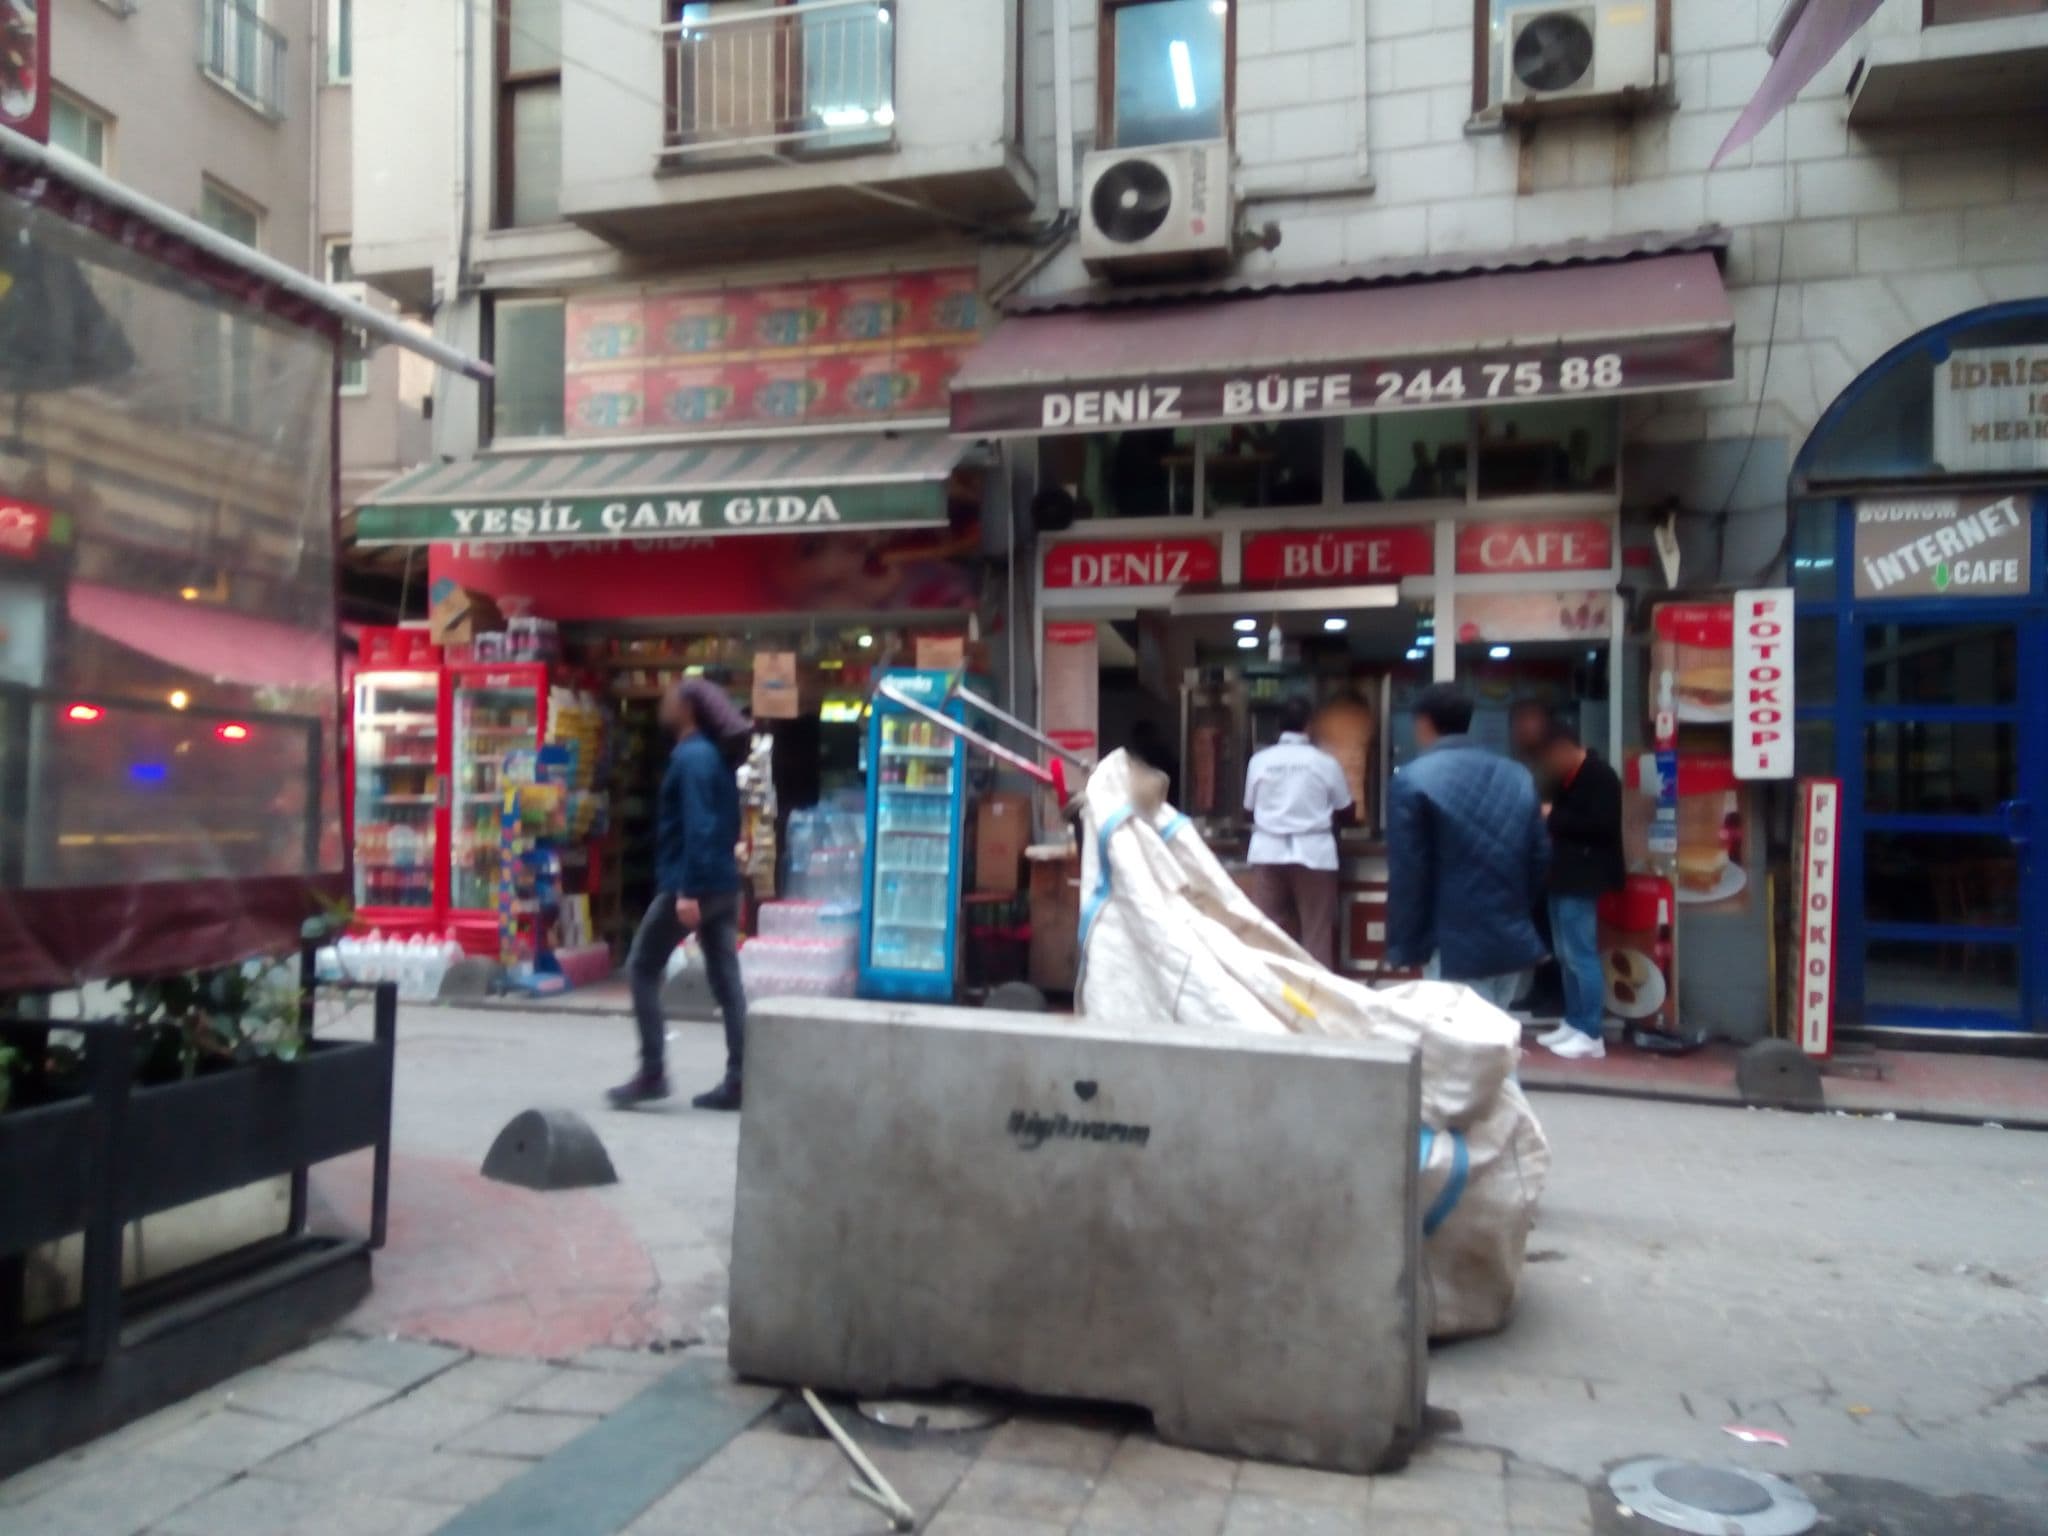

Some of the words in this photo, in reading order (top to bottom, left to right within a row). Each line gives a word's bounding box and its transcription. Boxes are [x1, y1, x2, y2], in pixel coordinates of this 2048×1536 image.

[1042, 384, 1182, 428] DENİZ
[1223, 373, 1352, 416] BÜFE
[1374, 366, 1466, 406] 244
[1482, 361, 1543, 398] 75
[1560, 353, 1624, 391] 88
[450, 501, 582, 538] YEŞİL
[601, 499, 702, 536] ÇAM
[724, 494, 840, 526] GIDA
[1863, 497, 2021, 590] İNTERNET
[1071, 550, 1190, 585] DENİZ
[1283, 536, 1392, 577] BÜFE
[1480, 530, 1587, 567] CAFE
[1954, 559, 2020, 585] CAFE
